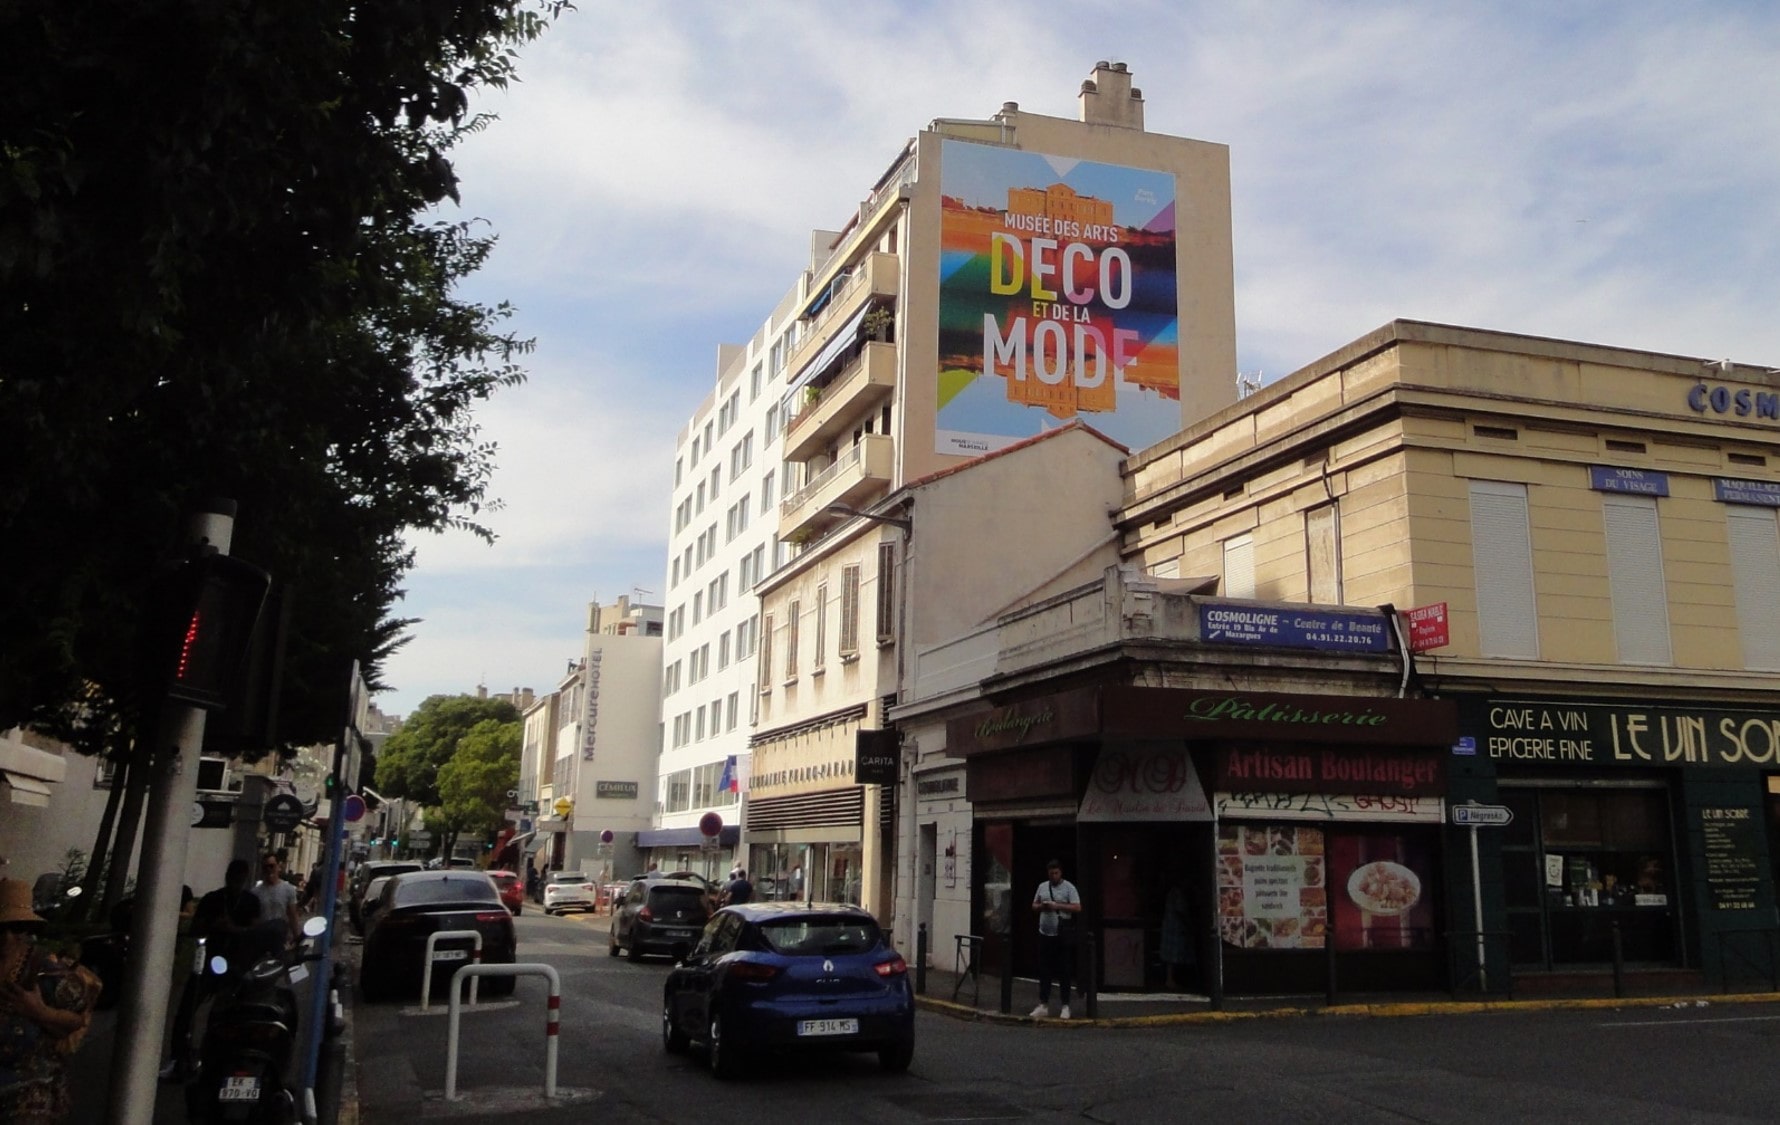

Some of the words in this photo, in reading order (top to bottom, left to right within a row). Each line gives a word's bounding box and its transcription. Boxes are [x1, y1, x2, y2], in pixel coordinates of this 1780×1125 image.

[1004, 212, 1050, 233] MUSÉE
[1054, 218, 1080, 238] DES
[1083, 223, 1118, 242] ARTS
[990, 231, 1132, 309] DECO
[1032, 301, 1049, 319] ET
[1052, 303, 1070, 321] DE
[1073, 306, 1091, 323] LA
[983, 312, 1140, 391] MODE
[1605, 479, 1619, 489] DU
[1624, 481, 1658, 492] VISAGE
[1615, 469, 1644, 479] SOINS
[1207, 610, 1279, 626] COSMOLIGNE
[1294, 617, 1326, 631] Centre
[1331, 620, 1343, 631] de
[1349, 621, 1382, 633] Beauté
[1183, 696, 1388, 727] Pâtisserie
[1490, 707, 1535, 731] CAVE
[1540, 709, 1554, 730] A
[1557, 710, 1588, 731] VIN
[1488, 736, 1556, 760] EPICERIE
[1559, 738, 1594, 761] FINE
[1610, 713, 1652, 761] LE
[1660, 715, 1709, 763] VIN
[861, 756, 894, 766] CARITA
[1227, 748, 1313, 779] Artisan
[1320, 751, 1438, 789] Boulanger
